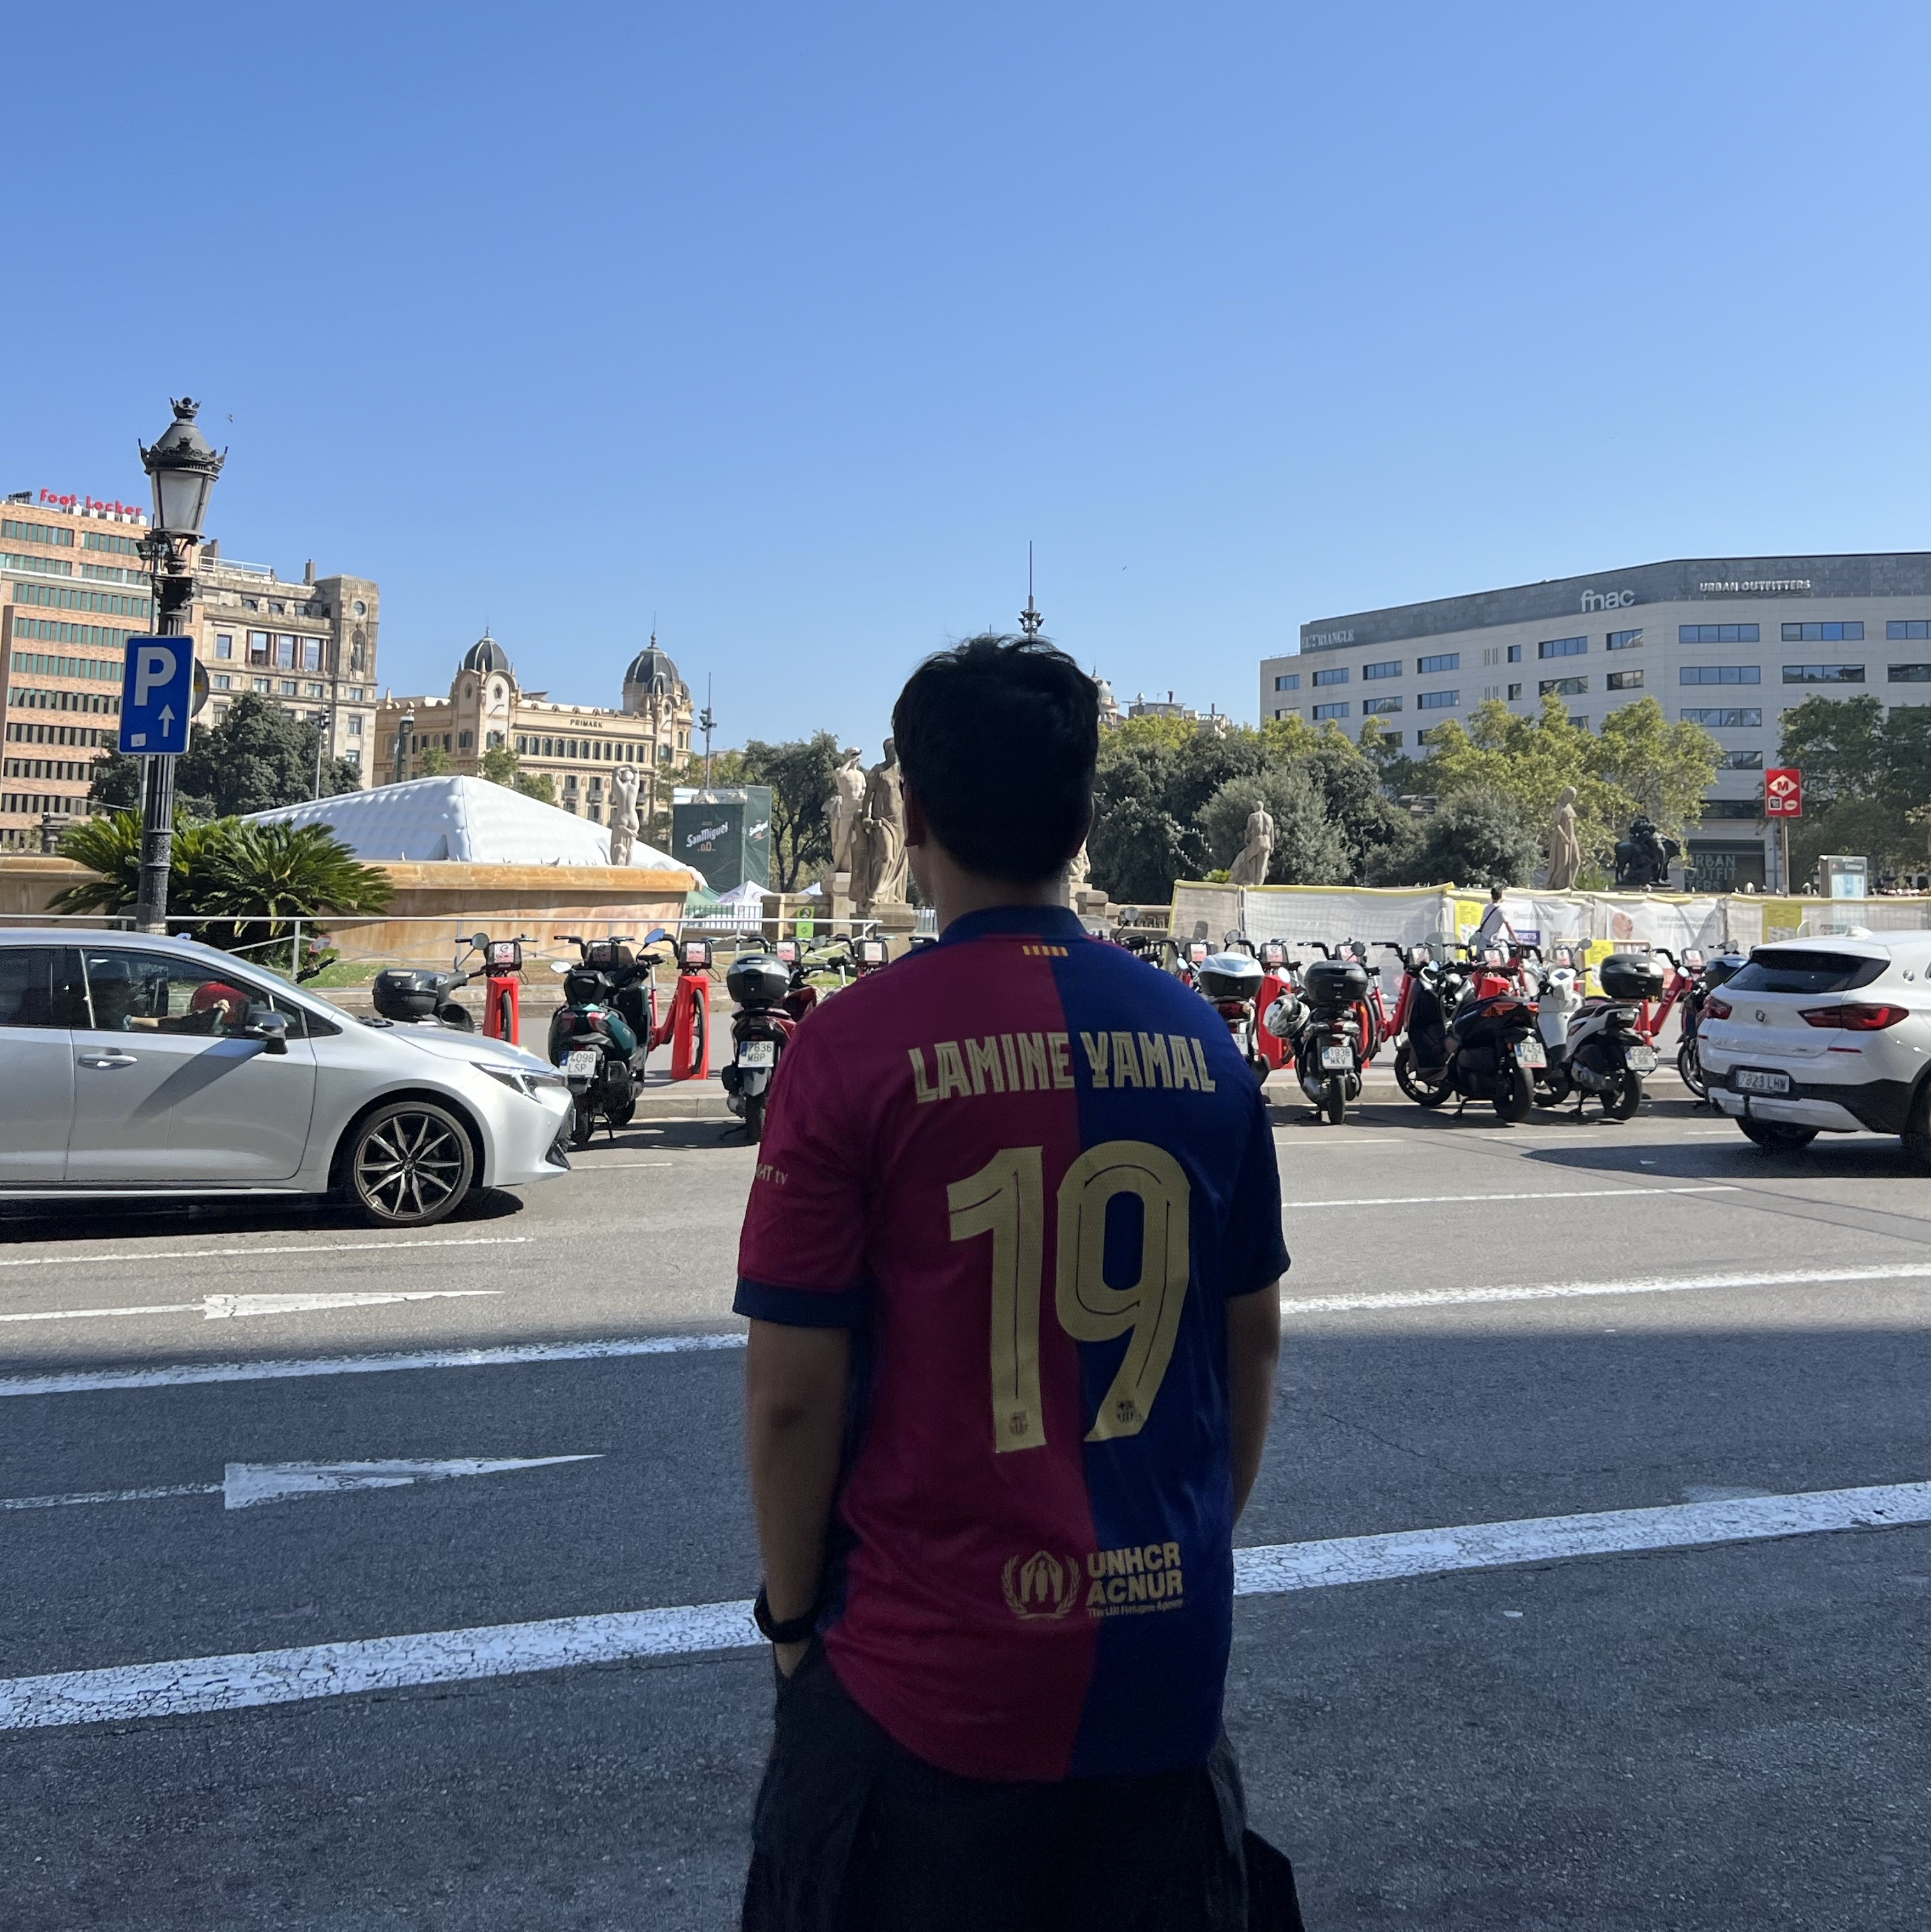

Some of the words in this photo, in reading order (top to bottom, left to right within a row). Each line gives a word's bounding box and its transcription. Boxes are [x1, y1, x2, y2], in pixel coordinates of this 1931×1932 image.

[40, 488, 77, 507] Foot
[86, 495, 142, 517] Locker
[1700, 581, 1738, 592] URBAN
[1742, 579, 1810, 592] OUTFITTERS
[1580, 589, 1635, 612] fnac
[134, 647, 176, 706] P
[569, 719, 602, 728] PRIMARK
[1777, 781, 1789, 791] M
[1695, 854, 1736, 867] RBAN
[1235, 1035, 1246, 1044] 33
[748, 1043, 773, 1053] 7636
[1522, 1045, 1542, 1054] 7452
[570, 1053, 594, 1063] 4098
[748, 1053, 765, 1062] MBP
[569, 1063, 586, 1073] LSP
[908, 1032, 1075, 1103] LAMINE
[1080, 1031, 1216, 1092] YAMAL
[947, 1140, 1191, 1453] 19
[1087, 1541, 1181, 1578] UNHCR
[1086, 1568, 1183, 1606] ACNUR
